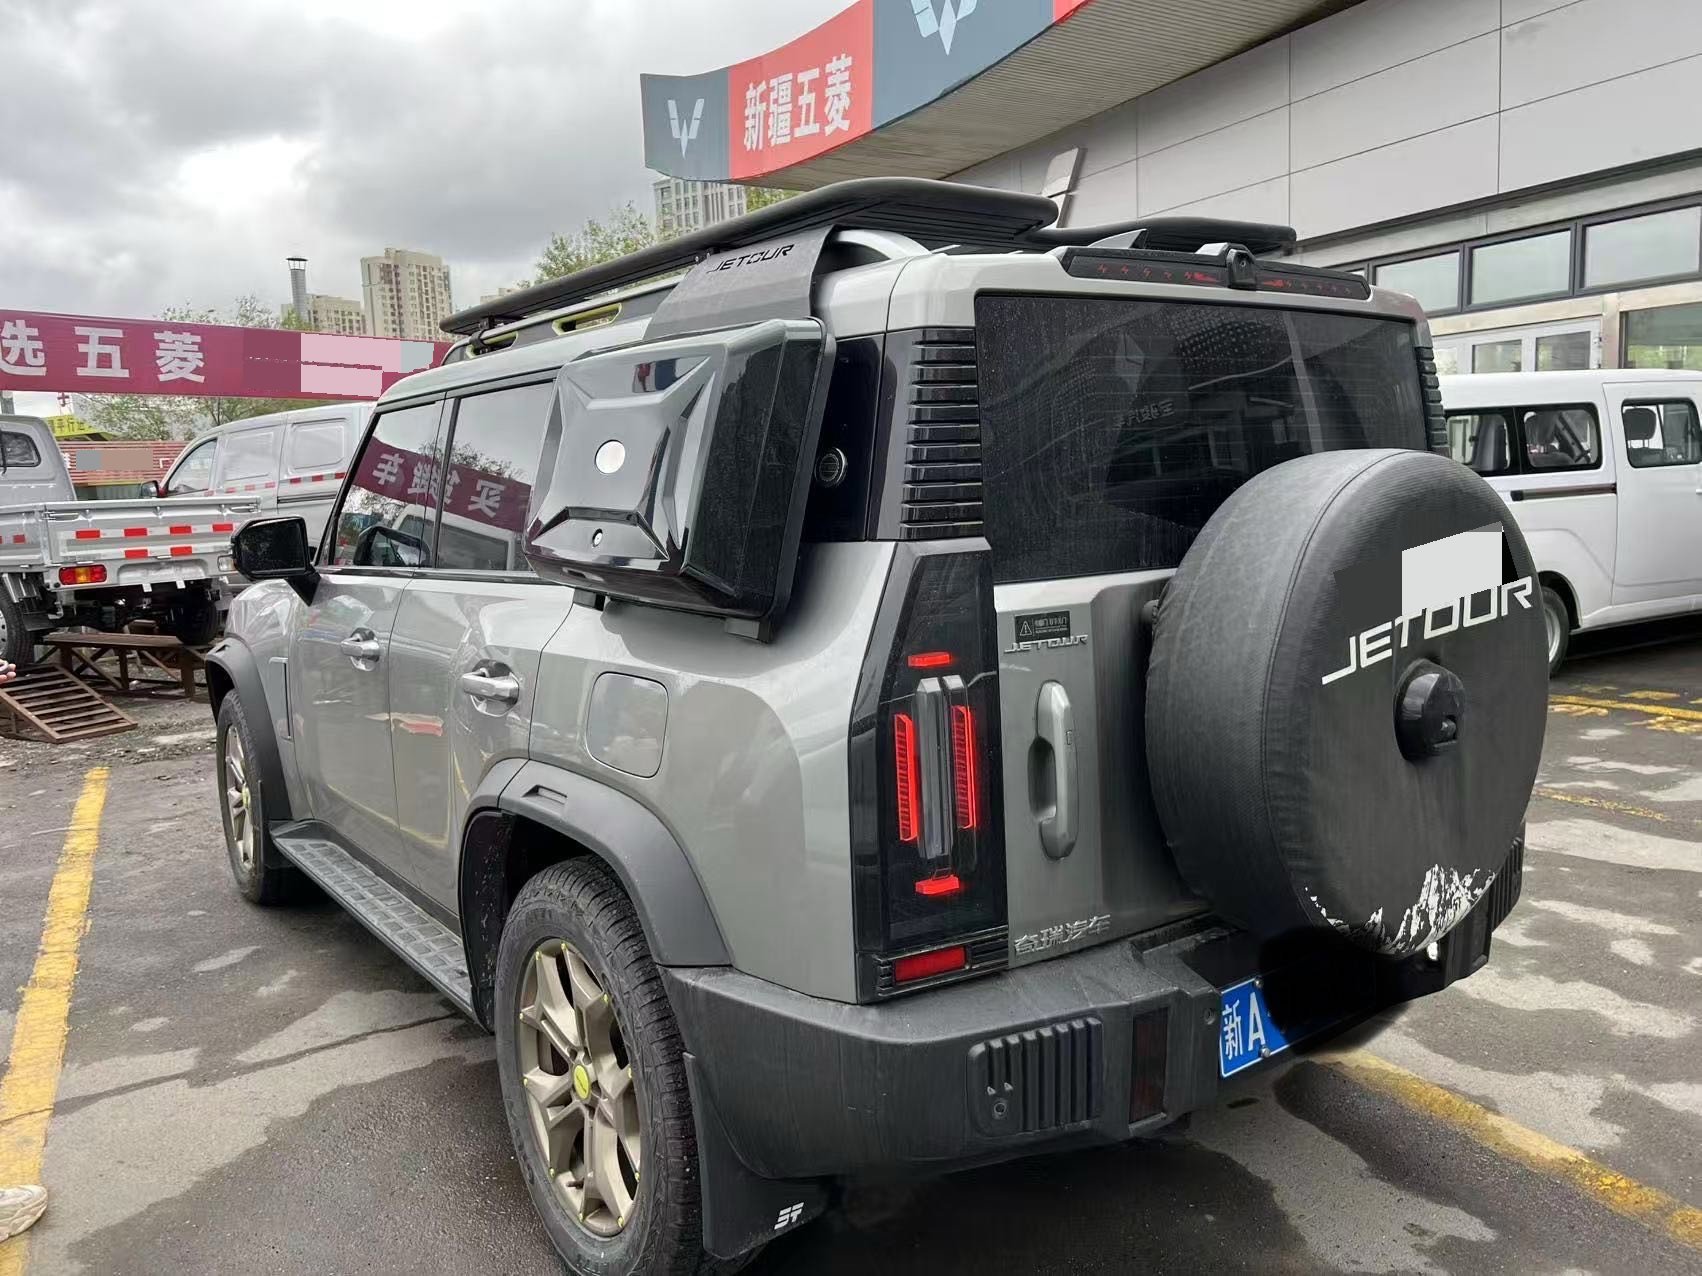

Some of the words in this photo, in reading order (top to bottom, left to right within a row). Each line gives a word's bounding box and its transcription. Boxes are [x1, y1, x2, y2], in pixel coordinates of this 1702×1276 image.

[743, 54, 852, 152] 新疆五菱
[706, 244, 795, 274] JETOUR
[0, 319, 205, 383] 选五菱
[1003, 634, 1088, 654] JETOUR
[1322, 576, 1532, 685] JETOUR
[1014, 914, 1111, 956] 奇瑞汽车
